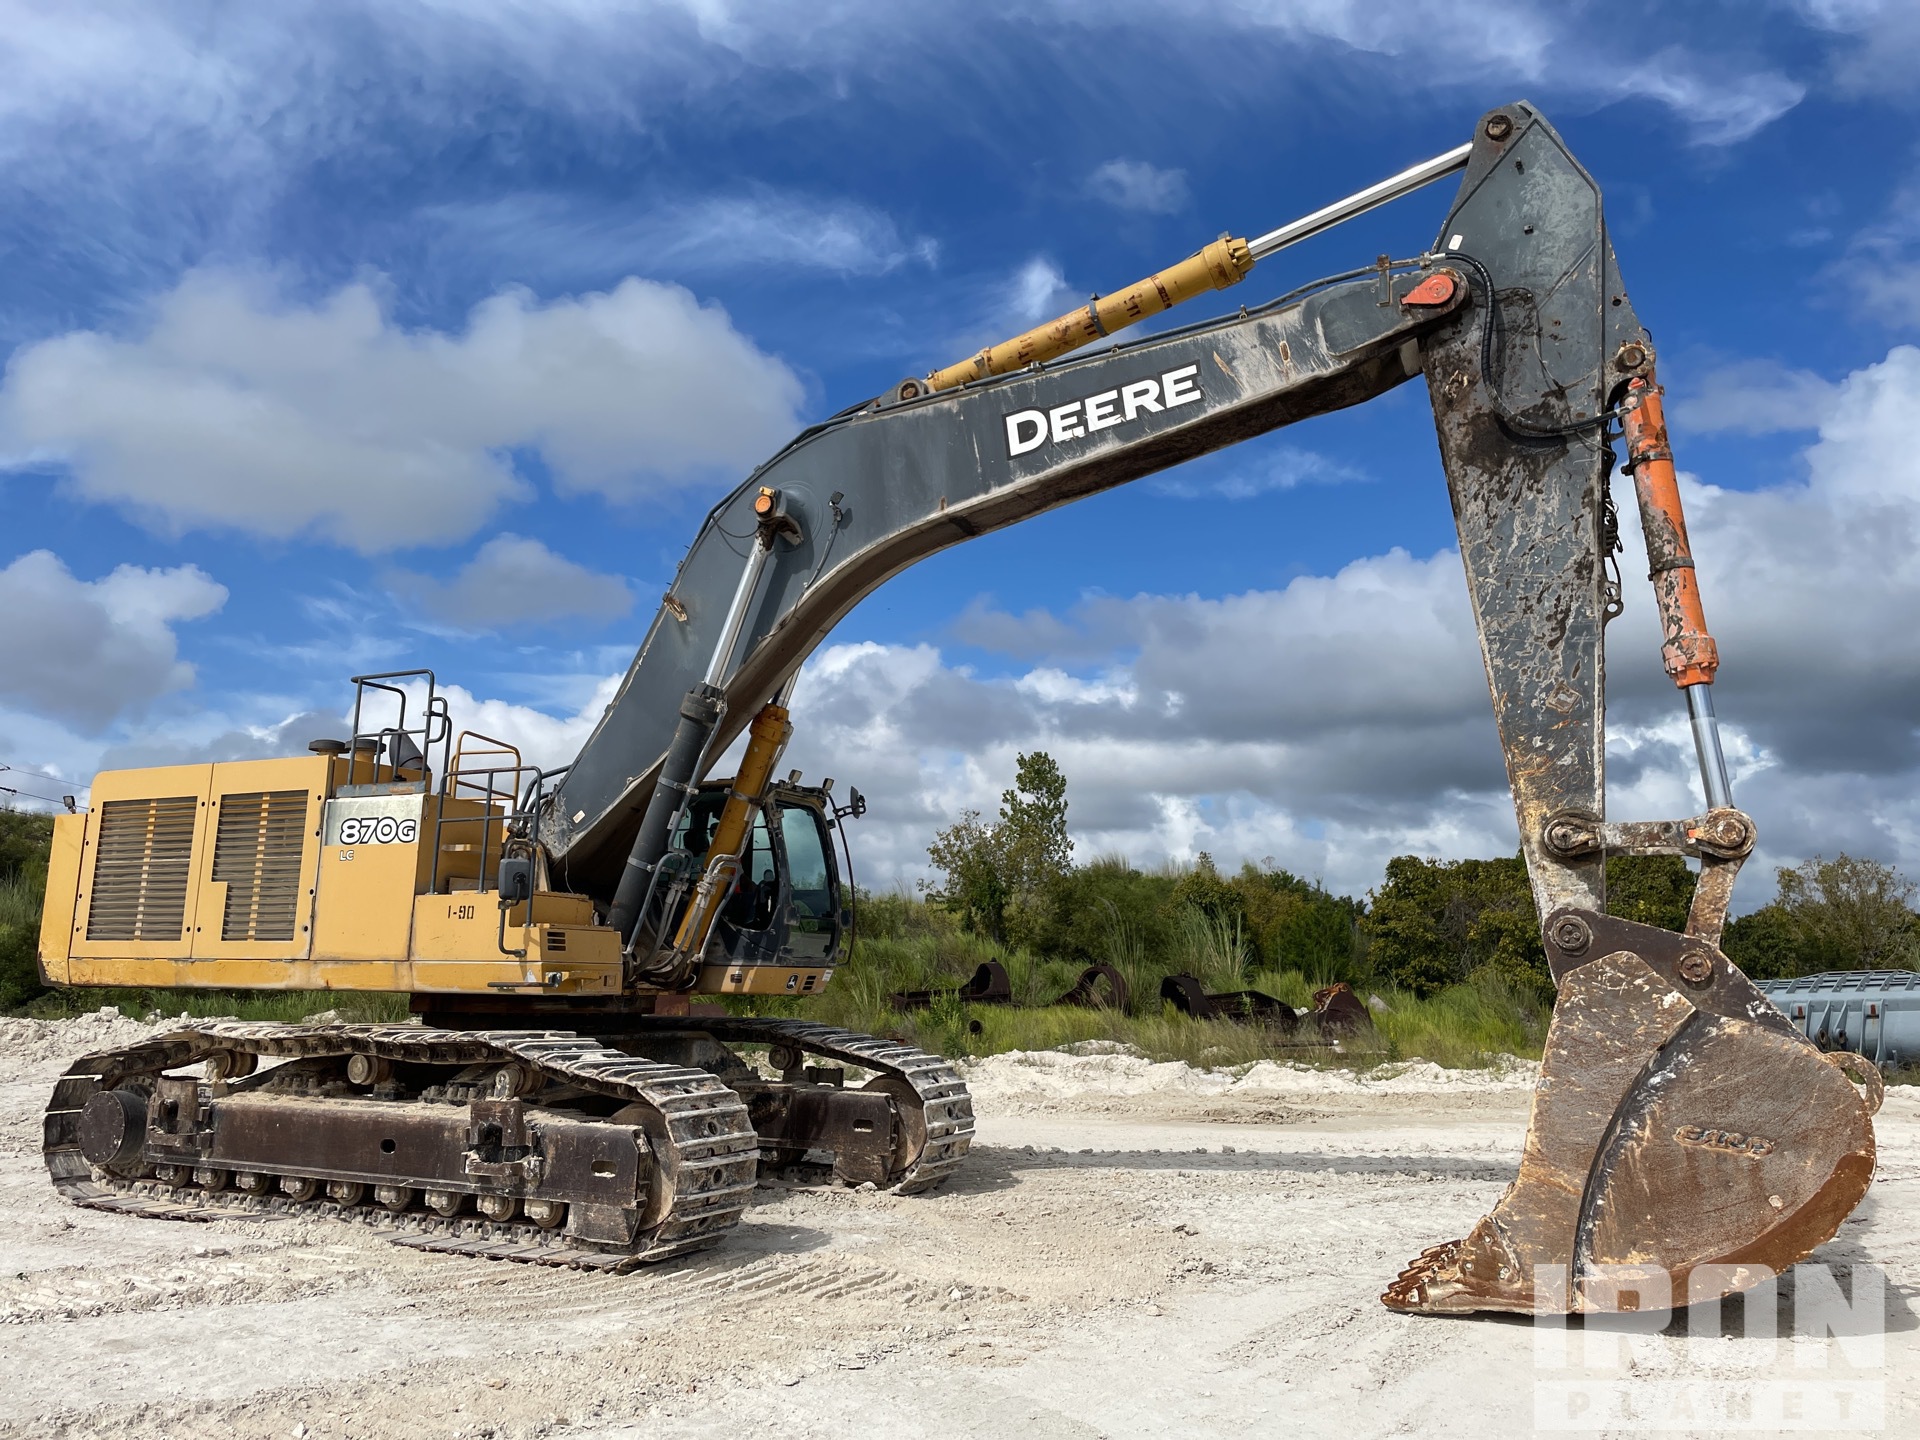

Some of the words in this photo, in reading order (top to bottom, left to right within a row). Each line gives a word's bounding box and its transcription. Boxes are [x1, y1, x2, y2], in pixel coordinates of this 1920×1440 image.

[1005, 364, 1201, 457] DEERE
[340, 816, 416, 845] 870G
[339, 850, 354, 861] LC
